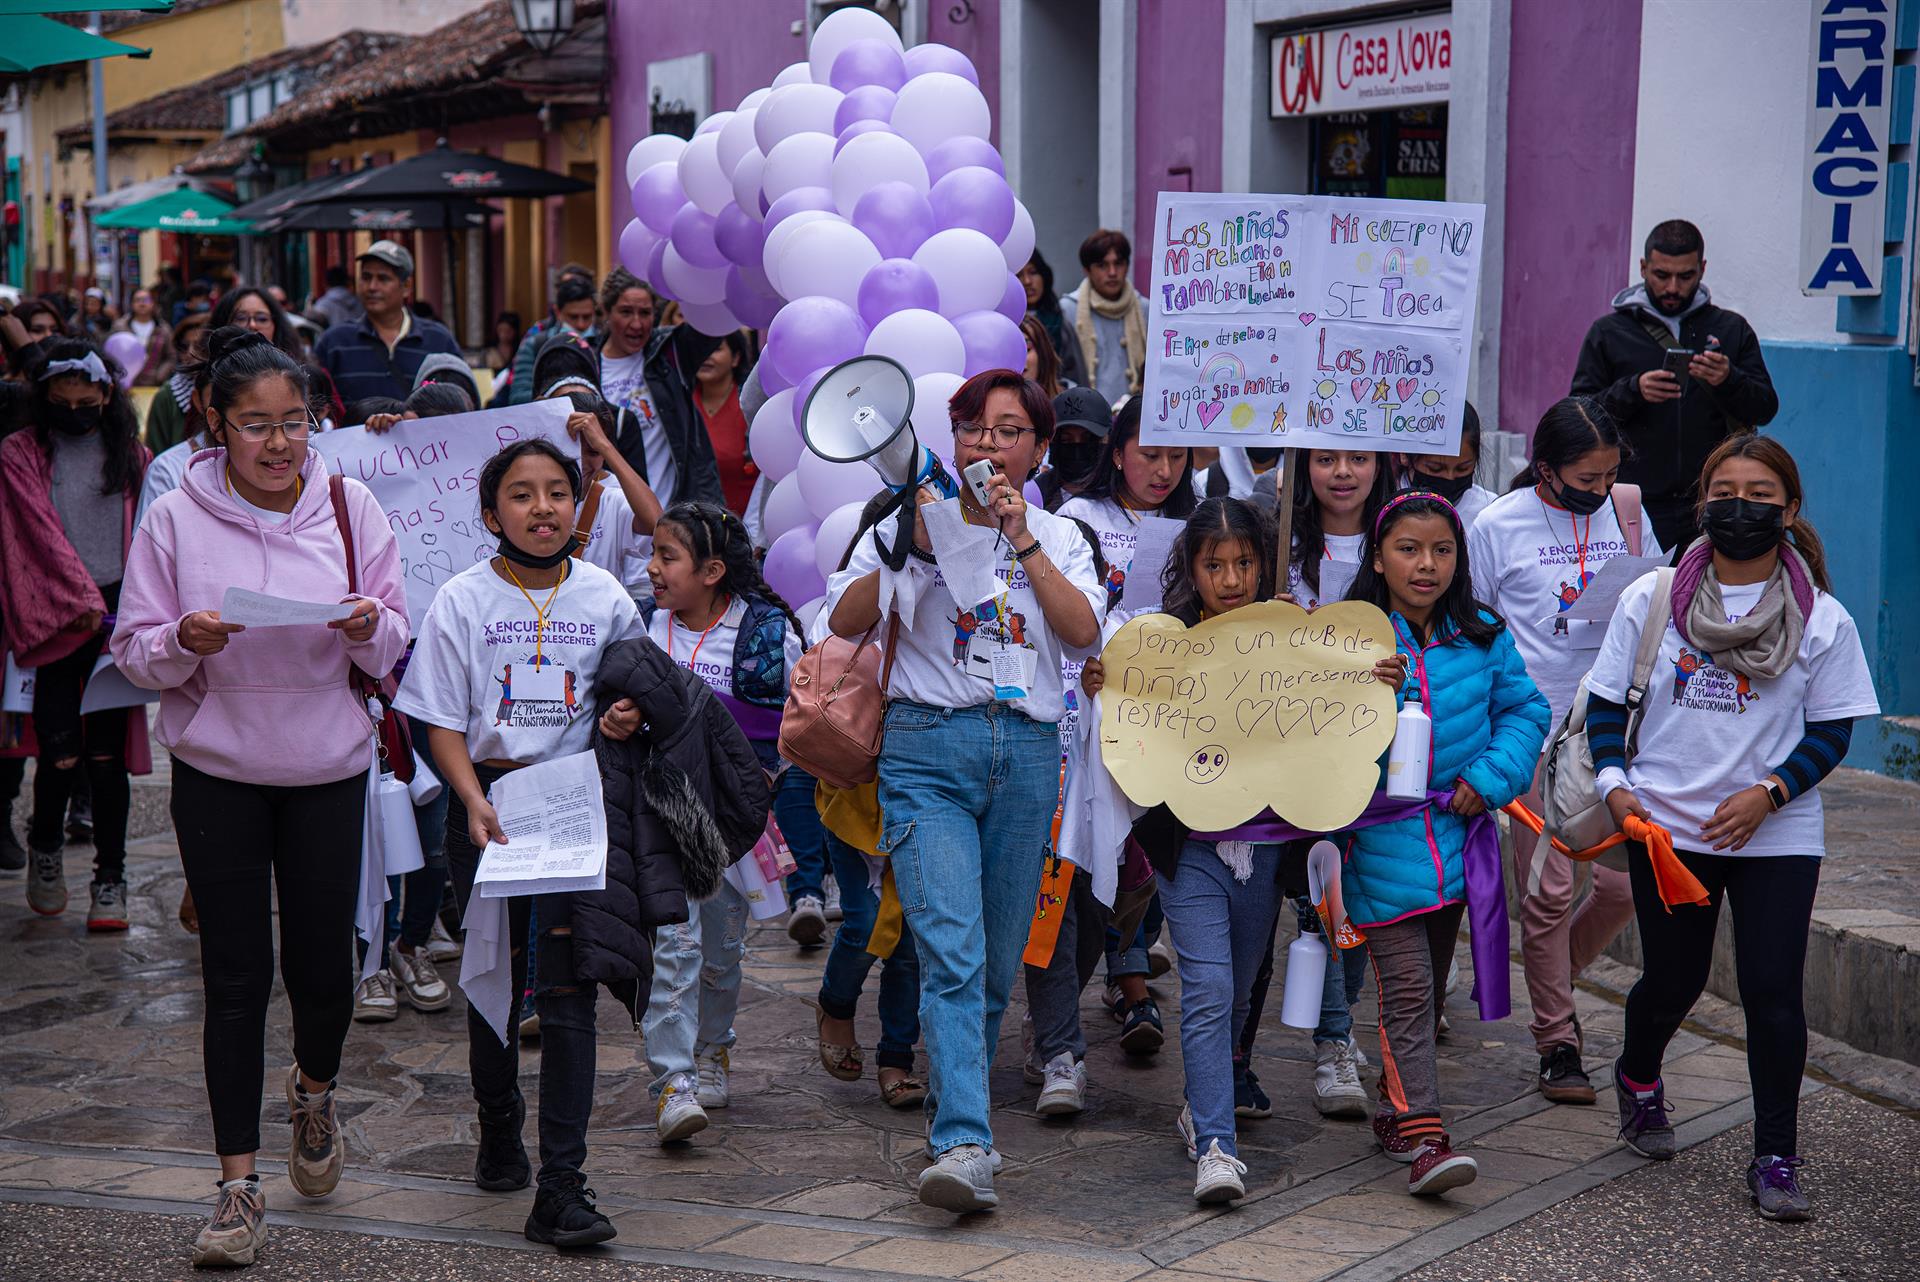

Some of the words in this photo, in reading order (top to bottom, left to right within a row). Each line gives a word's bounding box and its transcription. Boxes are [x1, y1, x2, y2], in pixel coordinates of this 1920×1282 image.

[1337, 32, 1389, 90] Casa
[1390, 26, 1452, 83] Nova
[1399, 140, 1440, 158] SAN
[1398, 158, 1441, 174] CRIS
[1167, 208, 1211, 248] Las
[1440, 221, 1472, 256] NO
[1325, 281, 1369, 318] SE
[1317, 327, 1366, 375] Las
[1307, 400, 1334, 428] NO
[1343, 408, 1368, 432] SE
[432, 467, 478, 495] las
[1538, 547, 1546, 557] X
[1540, 555, 1567, 566] NIÑAS
[484, 624, 493, 636] X
[496, 621, 577, 633] ENCUENTRO
[580, 623, 597, 636] DE
[486, 633, 513, 647] NIÑAS
[515, 635, 522, 643] Y
[524, 635, 597, 646] ADOLESCENTES
[1235, 630, 1274, 655] un
[1344, 629, 1373, 653] de
[1702, 669, 1729, 680] NIÑAS
[1691, 677, 1735, 690] LUCHANDO
[1684, 697, 1737, 713] TRANSFORMANDO
[511, 715, 568, 728] TRANSFORMANDO
